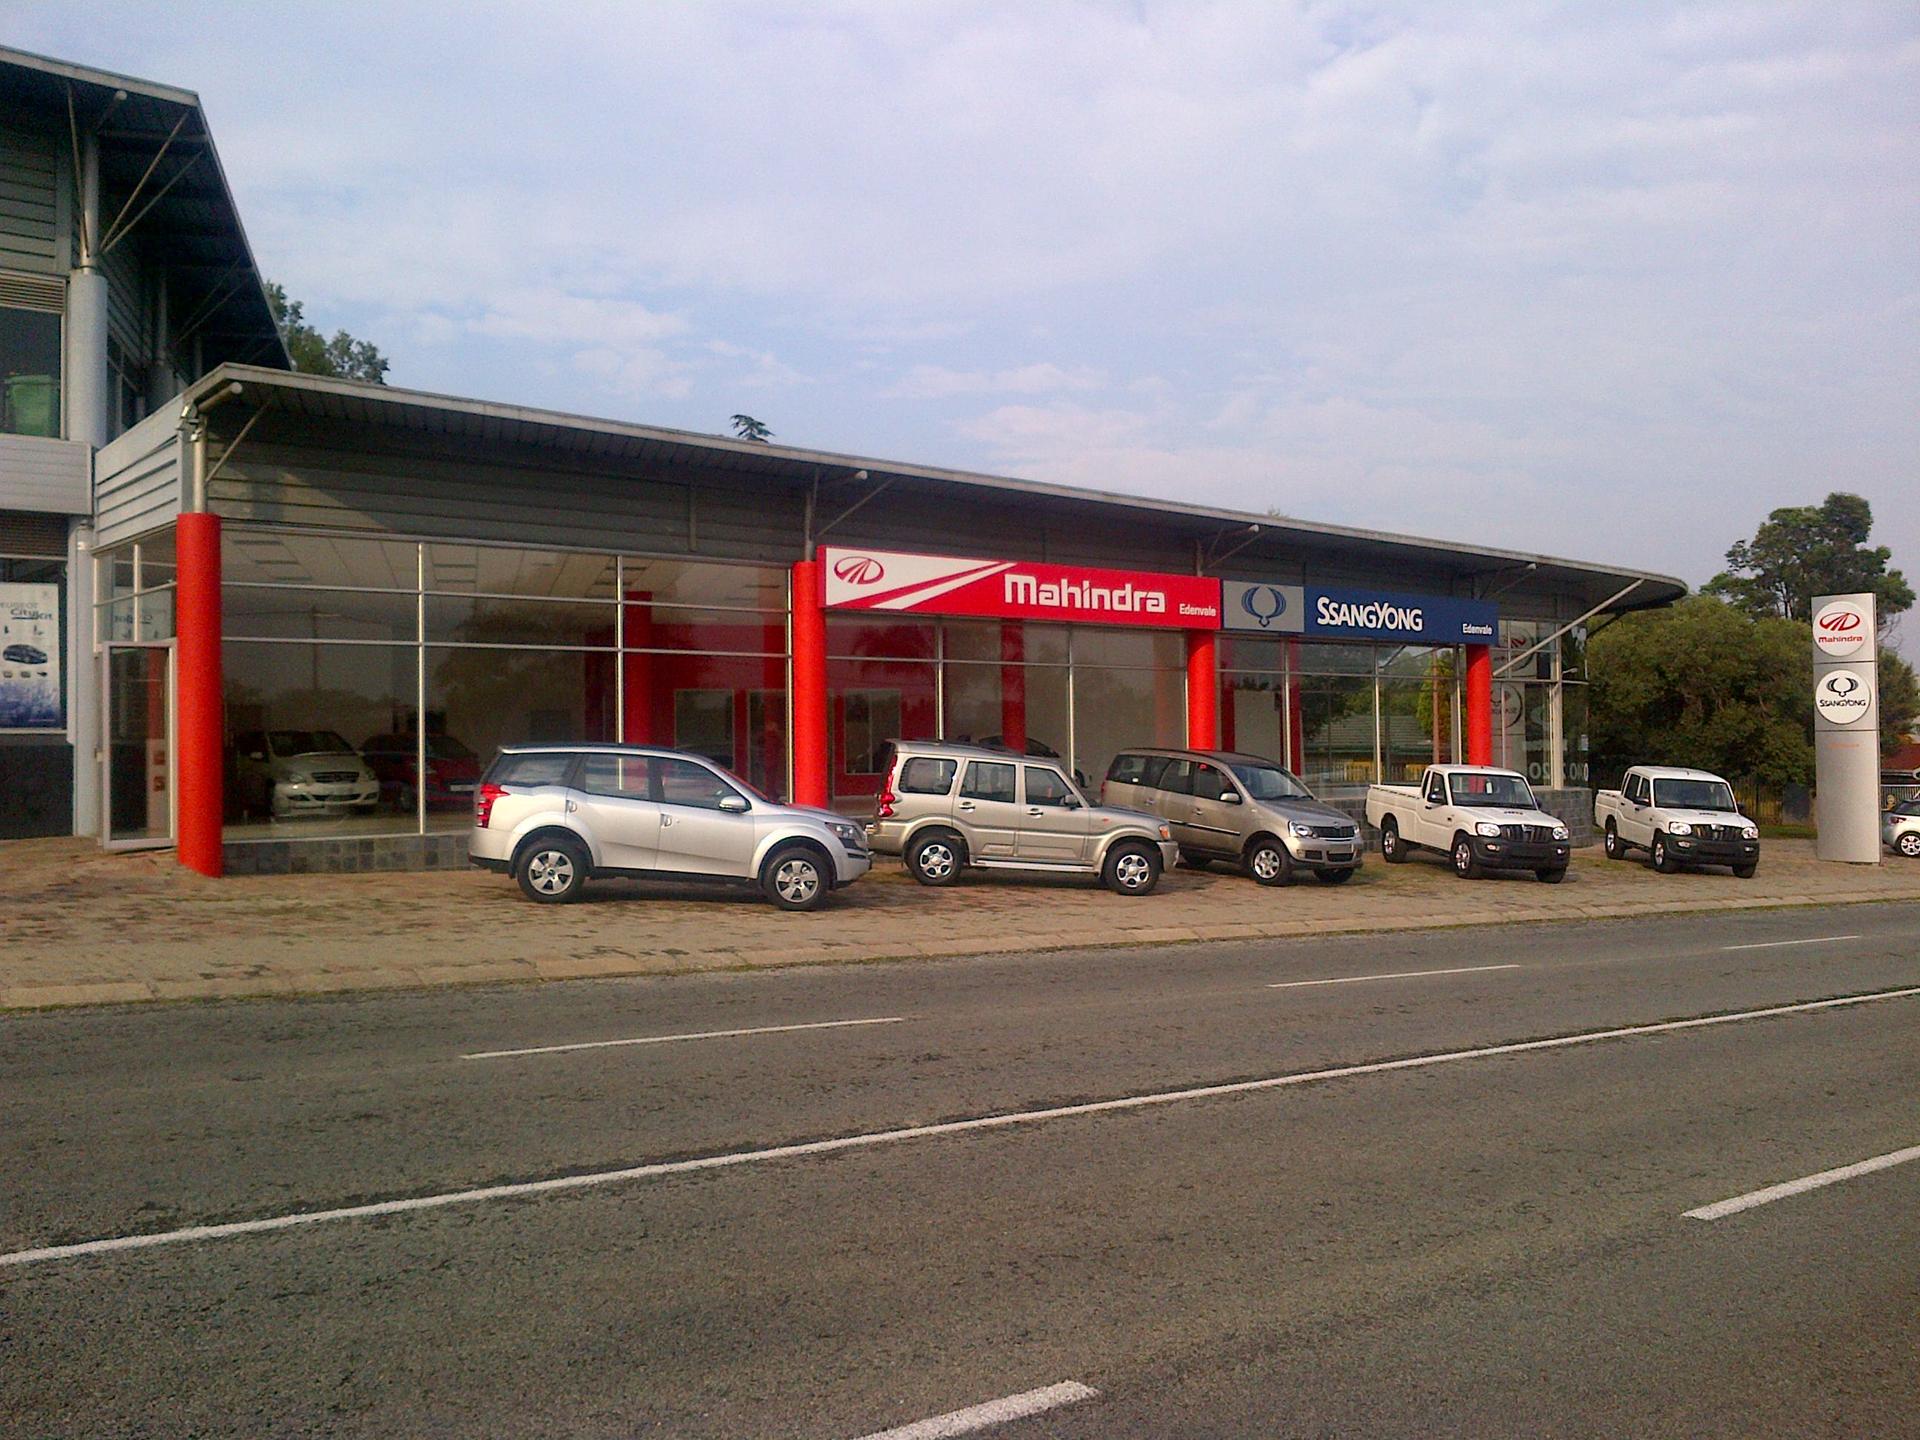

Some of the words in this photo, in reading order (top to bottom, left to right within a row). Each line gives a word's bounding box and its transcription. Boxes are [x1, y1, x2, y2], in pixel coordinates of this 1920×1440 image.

[1179, 603, 1217, 617] Edenvale
[1316, 597, 1423, 632] SSANGYONG
[1462, 623, 1493, 635] Edenvale
[1819, 699, 1866, 707] SSANGYONG
